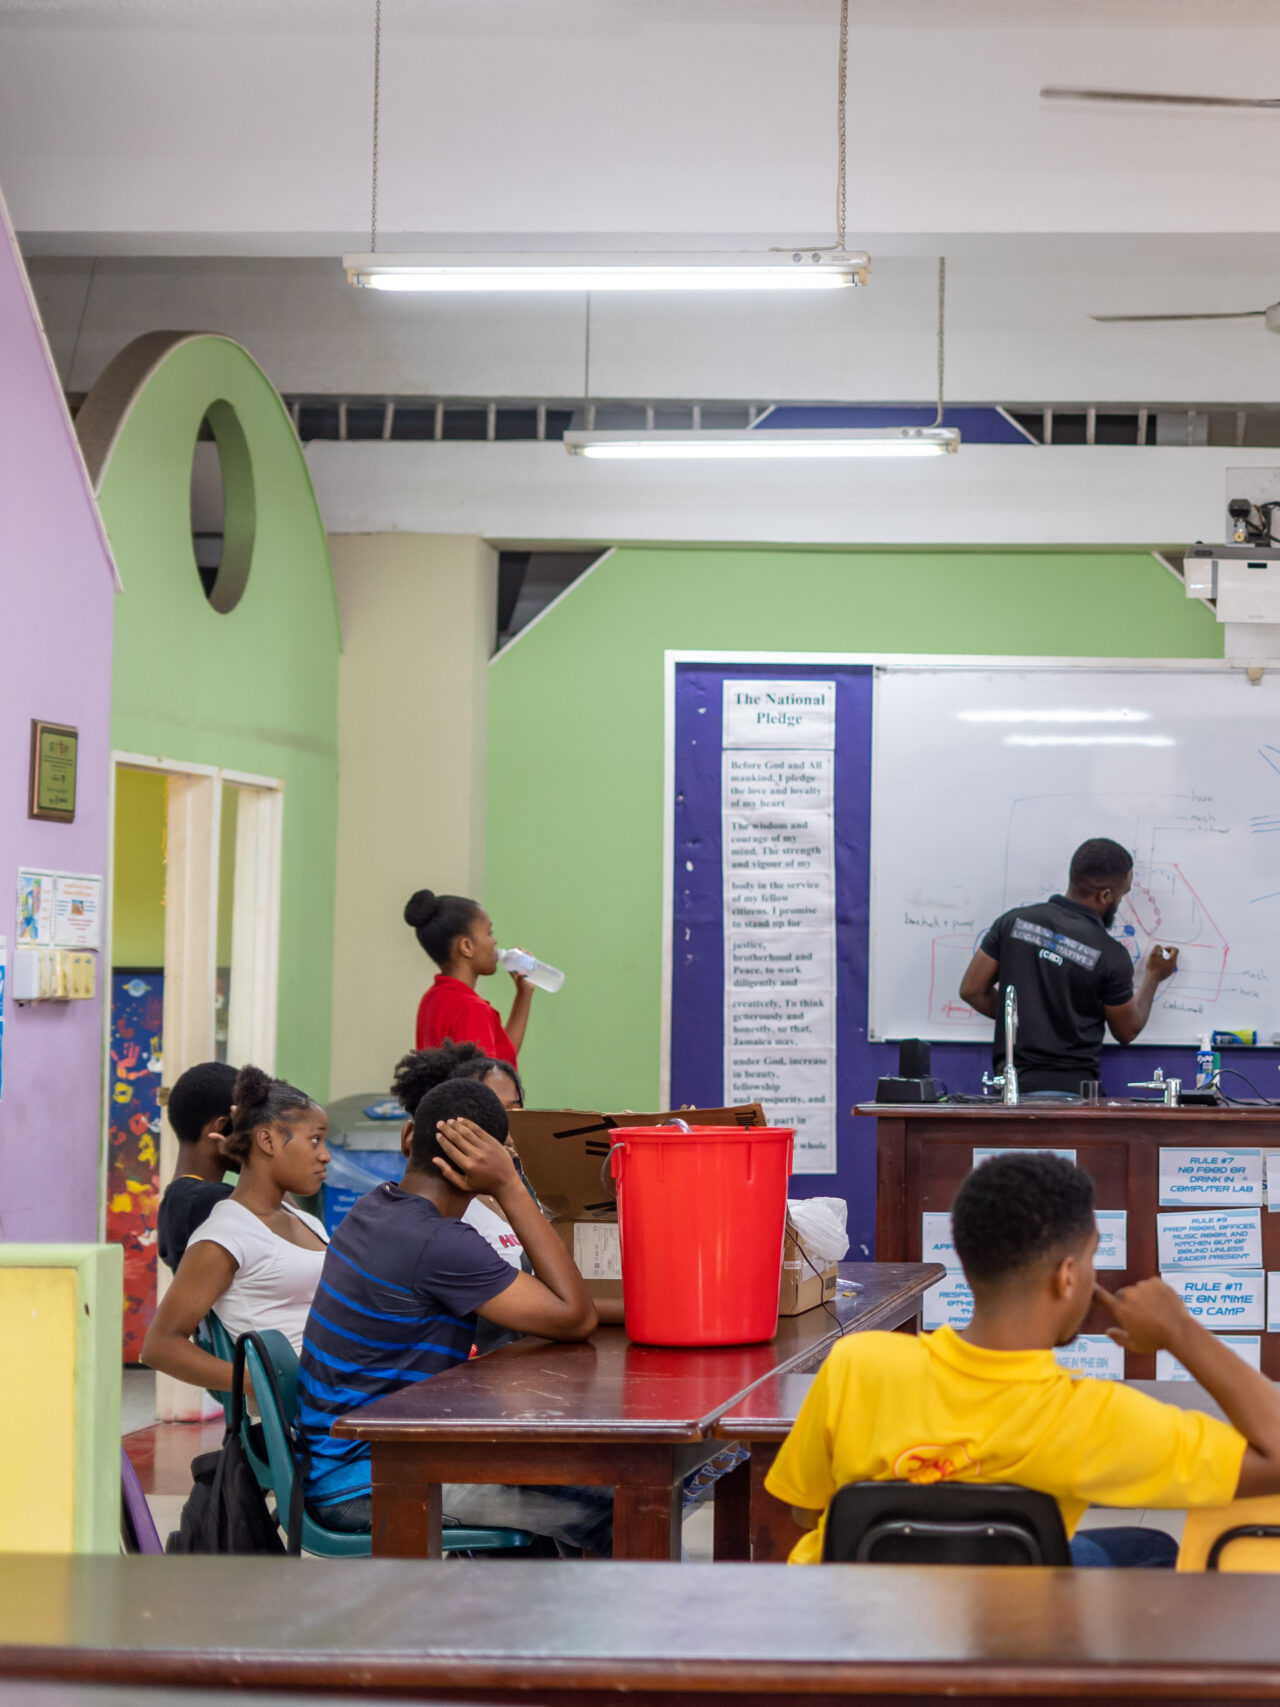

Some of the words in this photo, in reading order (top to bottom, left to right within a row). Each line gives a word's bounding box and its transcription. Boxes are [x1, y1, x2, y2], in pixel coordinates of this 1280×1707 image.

[734, 693, 761, 705] The
[766, 693, 825, 705] National
[757, 712, 802, 727] Pledge
[731, 761, 761, 769] Before
[764, 761, 784, 769] God
[788, 761, 805, 769] and
[809, 761, 822, 769] All
[778, 773, 782, 782] I
[785, 774, 816, 784] pledge
[730, 786, 745, 794] the
[748, 786, 766, 794] love
[770, 786, 788, 794] and
[790, 786, 821, 797] loyalty
[730, 799, 740, 808] of
[742, 800, 756, 810] my
[760, 799, 785, 808] heart
[732, 822, 749, 830] The
[752, 822, 788, 830] wisdom
[790, 821, 808, 829] and
[731, 836, 768, 844] courage
[770, 834, 780, 842] of
[783, 836, 796, 844] my
[762, 847, 779, 855] The
[782, 846, 821, 856] strength
[732, 860, 749, 868] and
[752, 860, 782, 869] vigour
[785, 860, 795, 868] of
[797, 861, 810, 870] my
[732, 882, 754, 892] body
[758, 882, 767, 890] in
[770, 882, 784, 890] the
[787, 881, 820, 889] service
[732, 894, 741, 902] of
[744, 896, 757, 904] my
[761, 894, 788, 902] fellow
[772, 906, 776, 914] I
[779, 906, 817, 917] promise
[732, 920, 741, 928] to
[744, 920, 770, 928] stand
[773, 920, 784, 930] up
[788, 920, 801, 928] for
[733, 952, 792, 961] brotherhood
[796, 952, 813, 960] and
[778, 966, 801, 974] work
[734, 978, 776, 990] diligently
[780, 978, 798, 986] and
[785, 999, 797, 1008] To
[800, 999, 824, 1008] think
[732, 1012, 782, 1022] generously
[786, 1012, 804, 1020] and
[732, 1038, 772, 1046] Jamaica
[789, 1057, 827, 1065] increase
[733, 1070, 742, 1078] in
[732, 1083, 781, 1092] fellowship
[808, 1095, 826, 1103] and
[774, 1117, 794, 1126] part
[797, 1116, 806, 1124] in
[800, 1142, 826, 1150] whole
[1178, 1166, 1194, 1174] NO
[1196, 1166, 1228, 1174] FOOD
[1230, 1166, 1246, 1174] OR
[1184, 1282, 1222, 1291] RULE
[1225, 1282, 1243, 1291] #11
[1196, 1294, 1217, 1304] ON
[1220, 1294, 1254, 1304] TIME
[1206, 1307, 1246, 1316] CAMP
[1080, 1357, 1095, 1368] THE
